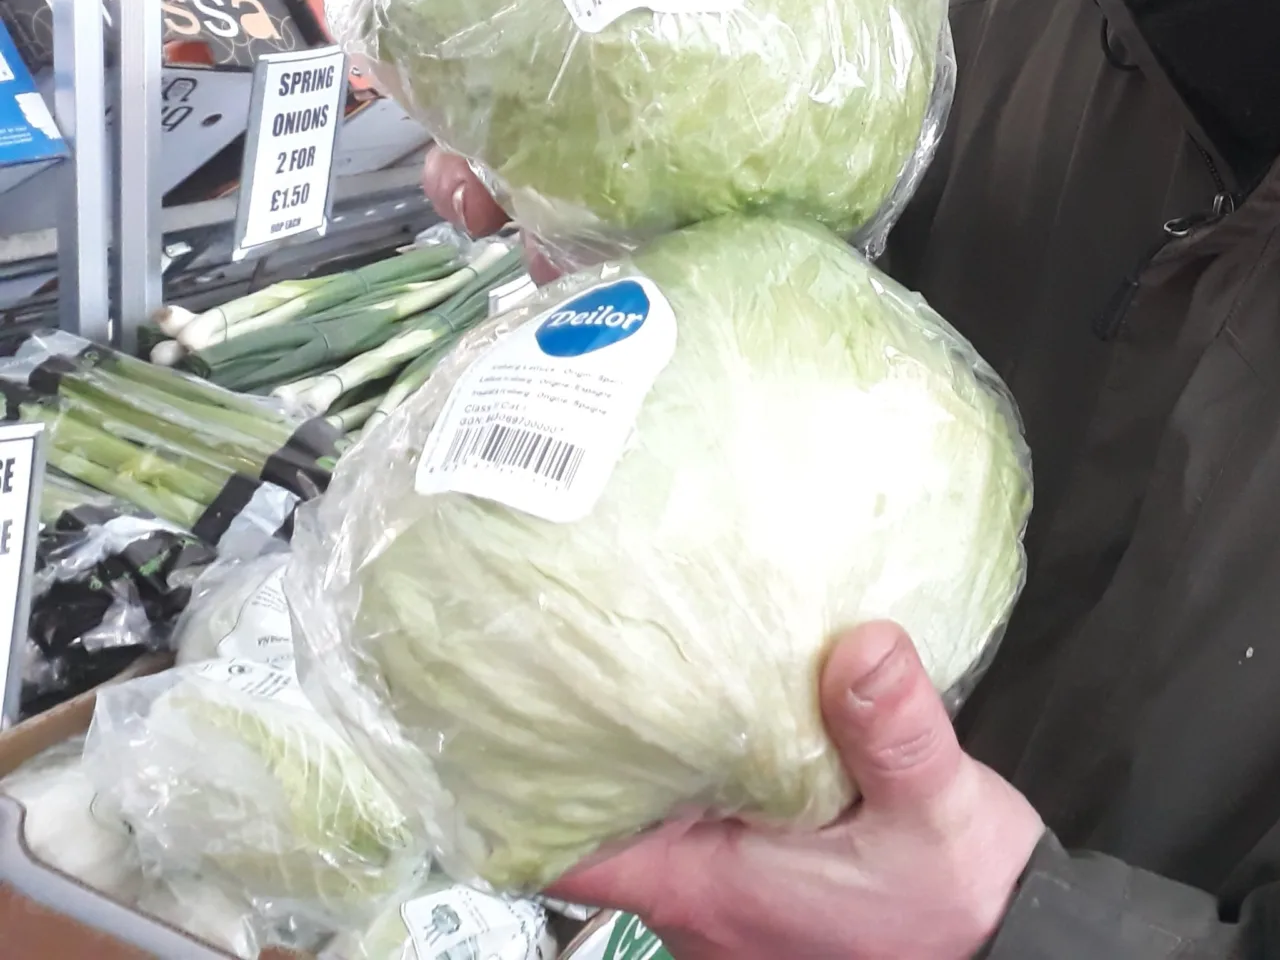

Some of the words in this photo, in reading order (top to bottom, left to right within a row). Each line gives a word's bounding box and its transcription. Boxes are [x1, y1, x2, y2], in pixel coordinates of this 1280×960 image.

[278, 65, 335, 97] SPRING
[272, 104, 329, 137] ONIONS
[275, 151, 287, 175] 2
[288, 145, 316, 172] FOR
[270, 182, 311, 213] £1.50
[285, 217, 302, 230] EACH
[550, 304, 643, 329] Deilor
